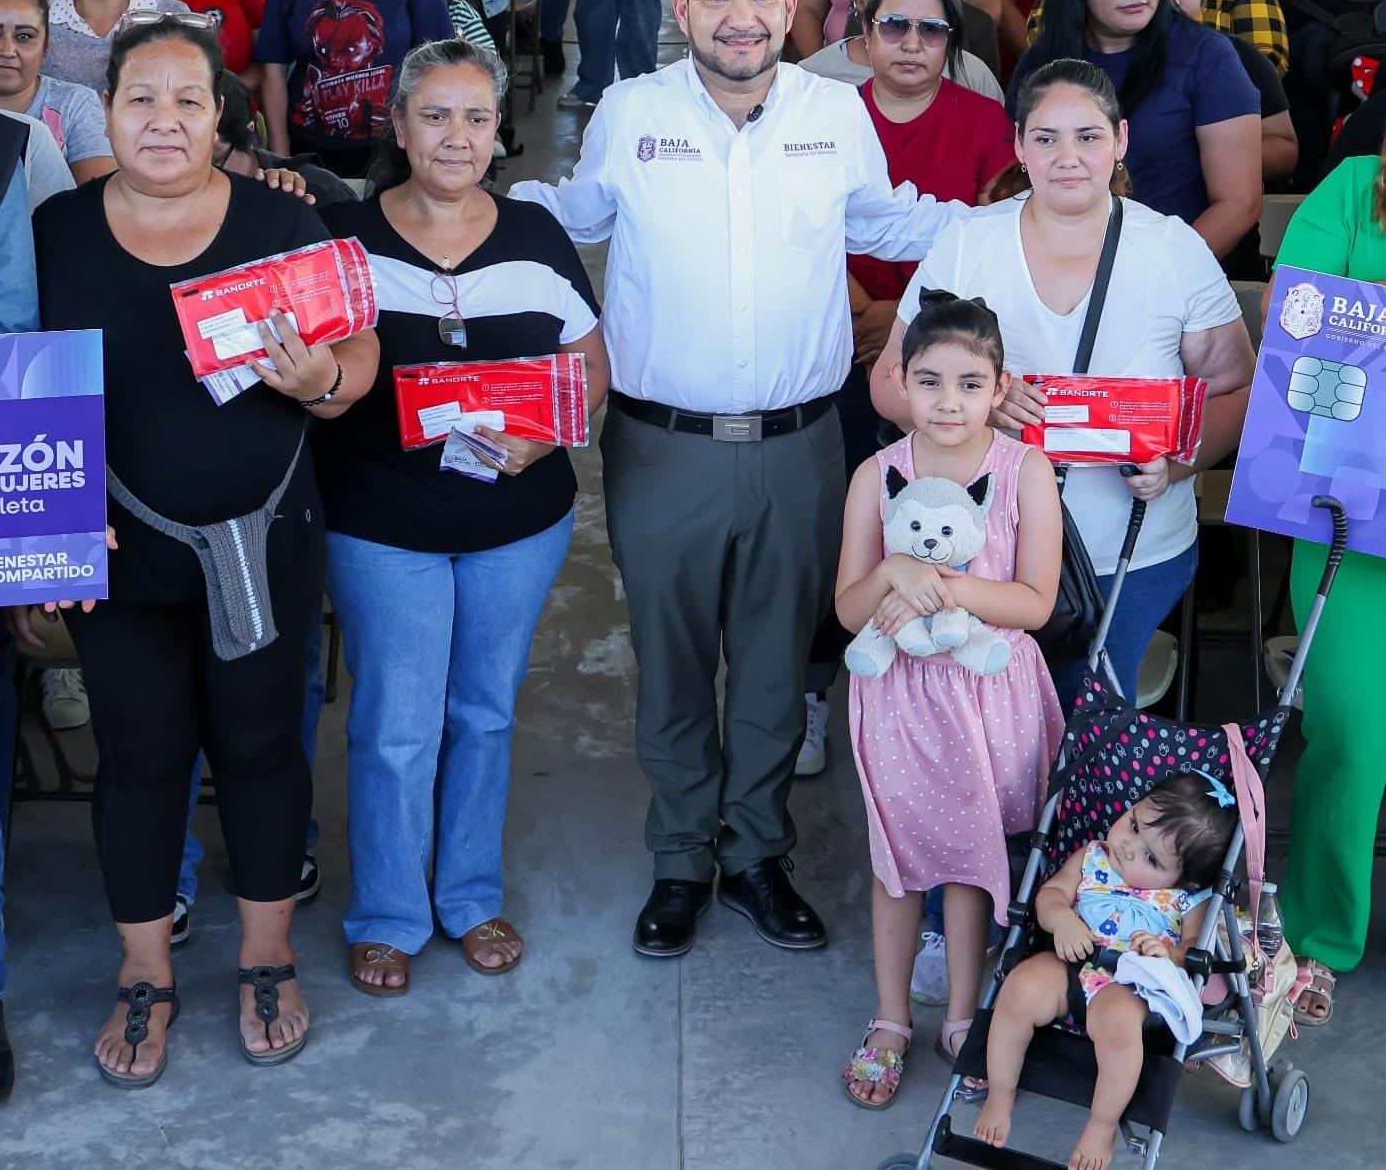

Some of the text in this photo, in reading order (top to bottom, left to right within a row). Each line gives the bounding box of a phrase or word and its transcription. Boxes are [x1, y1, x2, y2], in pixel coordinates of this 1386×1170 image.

[660, 139, 689, 147] BAJA
[784, 142, 836, 151] BIENESTAR
[215, 277, 267, 297] BANORTE
[1325, 333, 1363, 346] GOBIERNO
[1365, 341, 1380, 349] DEL
[432, 376, 480, 385] BANORTE
[1060, 389, 1109, 398] BANORTE
